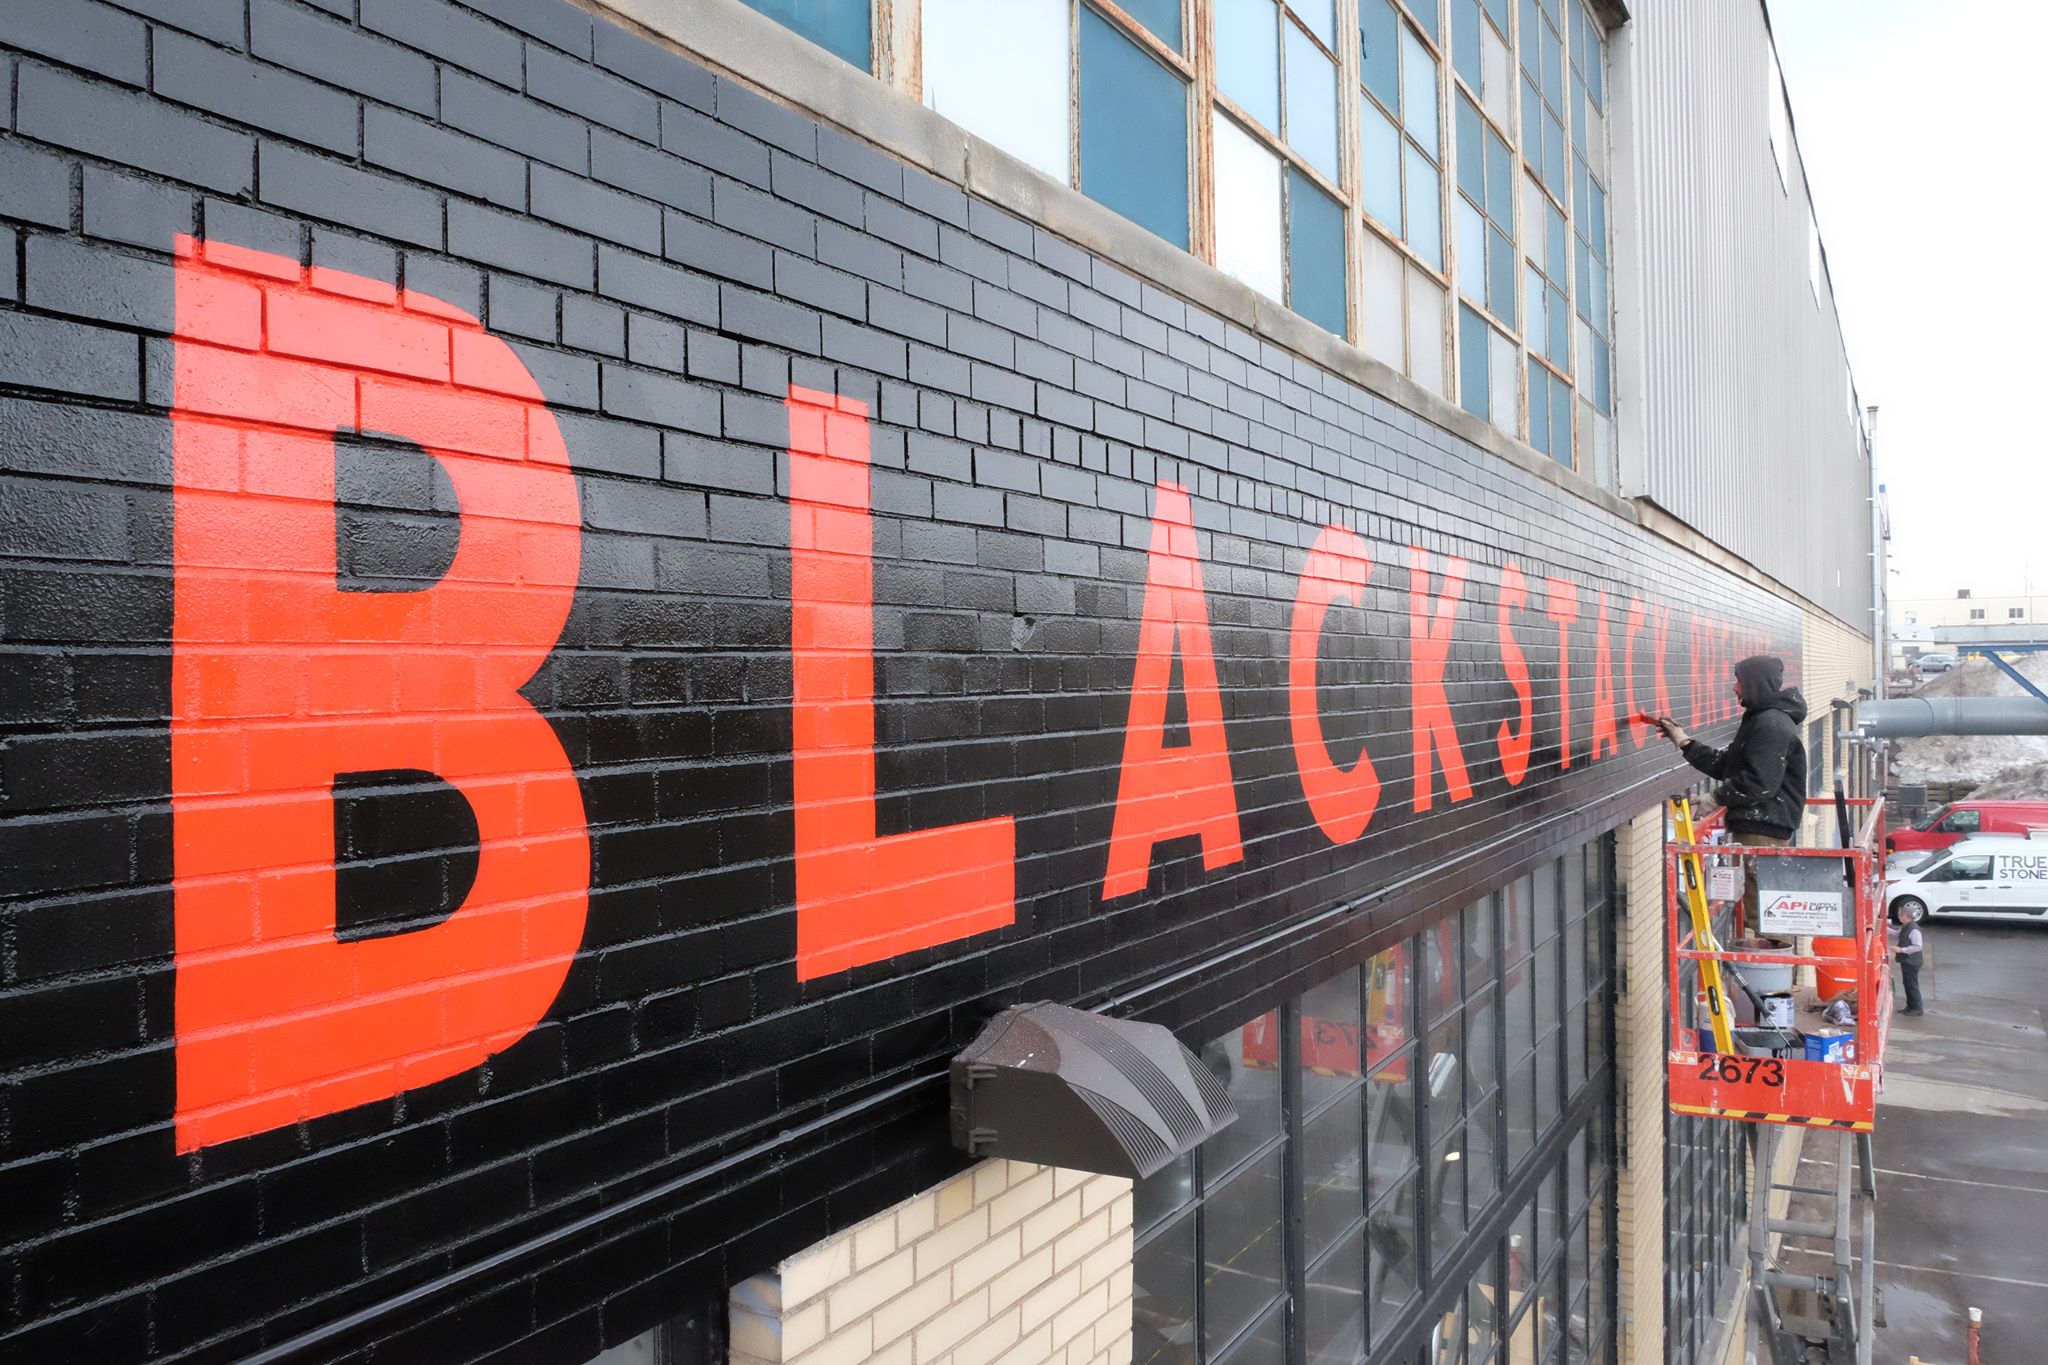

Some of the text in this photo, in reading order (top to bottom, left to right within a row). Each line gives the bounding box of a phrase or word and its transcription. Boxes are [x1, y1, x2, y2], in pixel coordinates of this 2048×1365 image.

[172, 232, 1672, 1156] BLACKSTACK
[1998, 855, 2048, 869] TRUE
[1999, 868, 2048, 880] STONE
[1698, 1053, 1785, 1088] 2673
